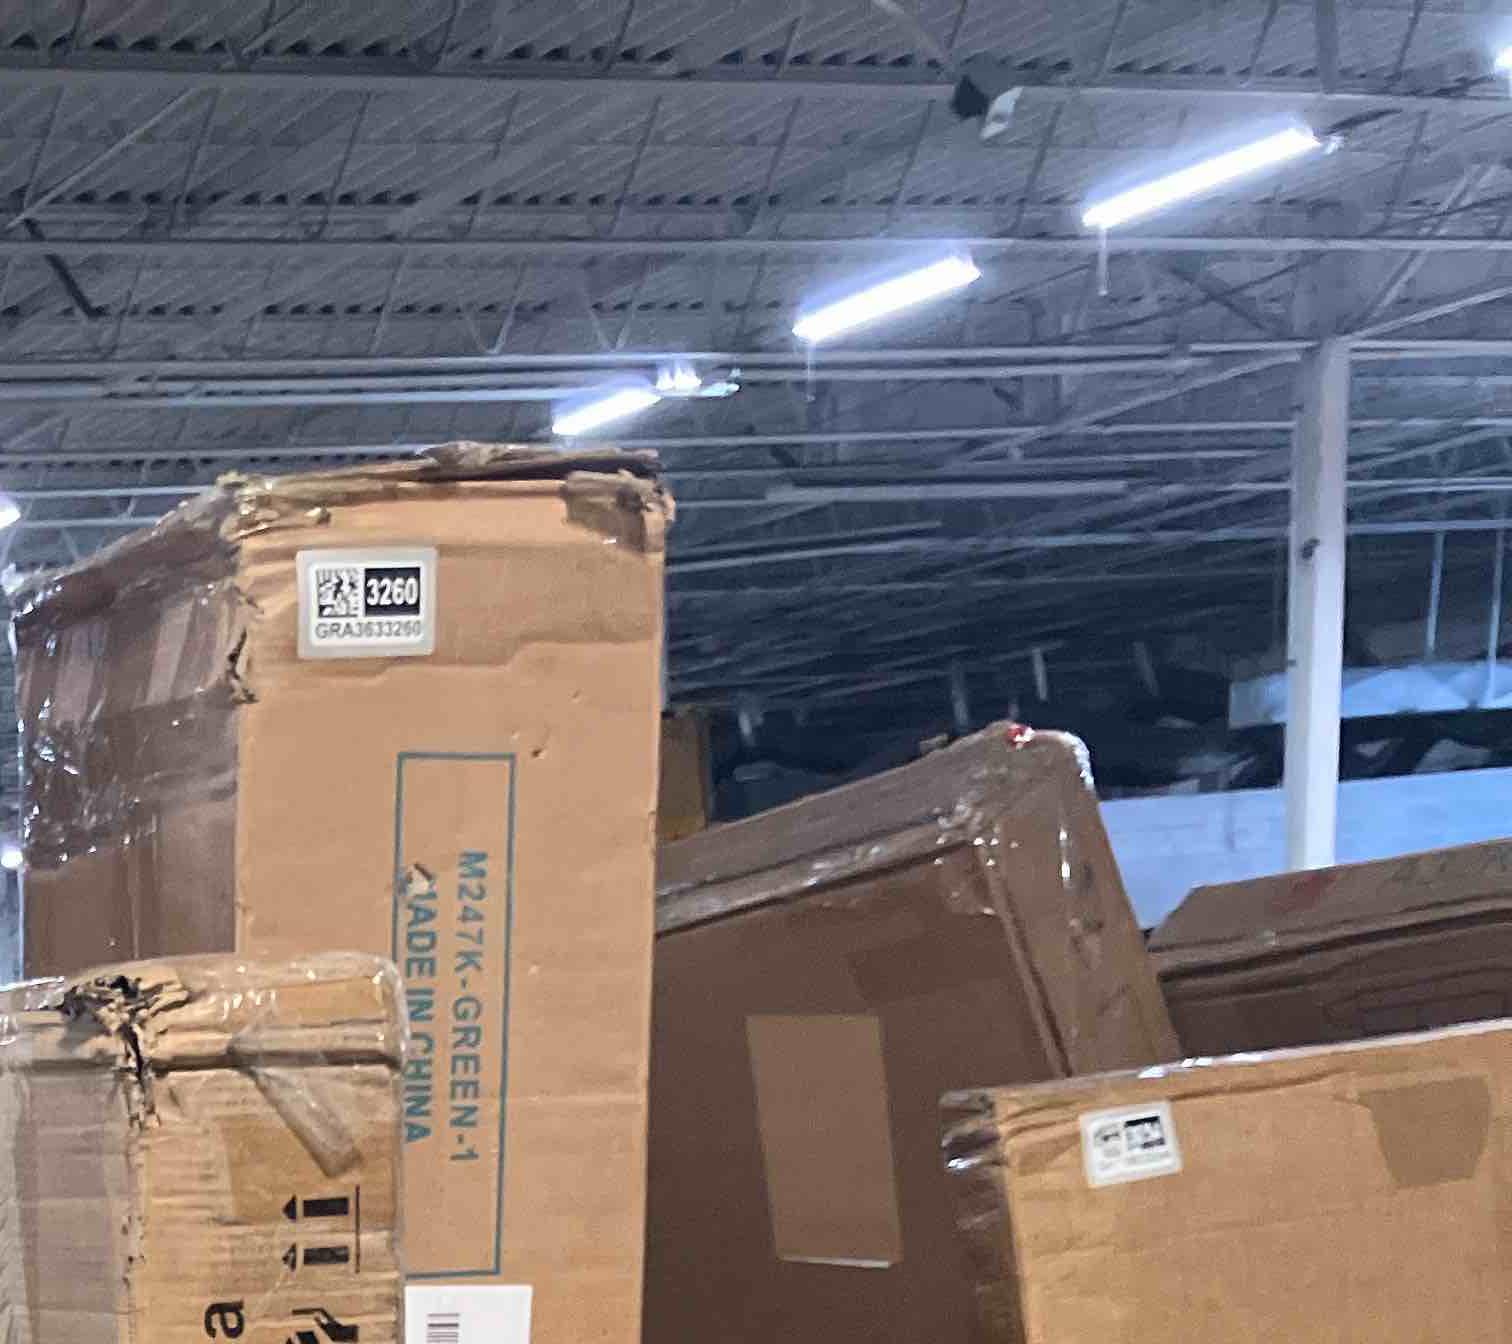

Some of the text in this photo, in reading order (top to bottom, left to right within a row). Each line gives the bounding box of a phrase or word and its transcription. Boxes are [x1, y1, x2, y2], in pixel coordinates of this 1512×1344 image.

[365, 575, 419, 607] 3260
[314, 617, 422, 641] GRA3633260
[405, 985, 437, 1022] IN
[447, 850, 489, 1163] M247K-GREEN-1
[401, 1033, 434, 1144] CHINA
